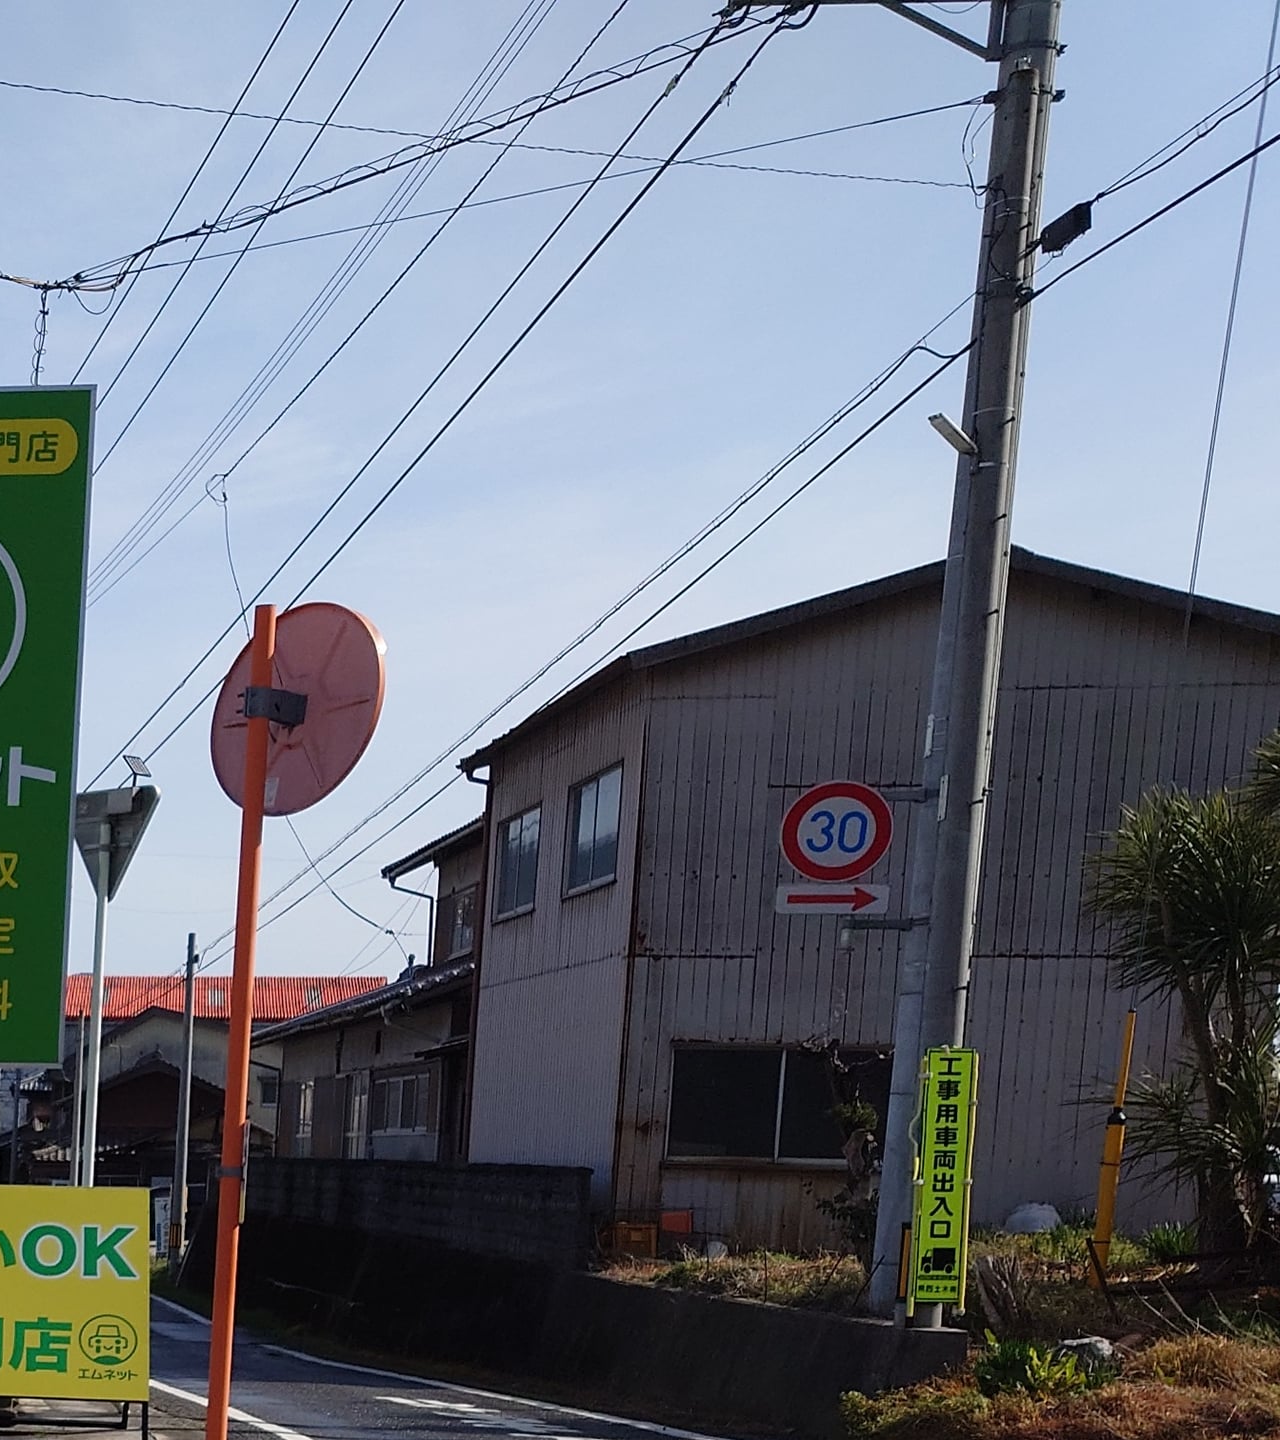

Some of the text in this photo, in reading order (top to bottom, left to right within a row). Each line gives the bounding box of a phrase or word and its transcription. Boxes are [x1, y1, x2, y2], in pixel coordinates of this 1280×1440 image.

[805, 809, 869, 854] 30
[928, 1057, 963, 1239] 工事用車両出入口
[77, 1367, 139, 1382] エムネット
